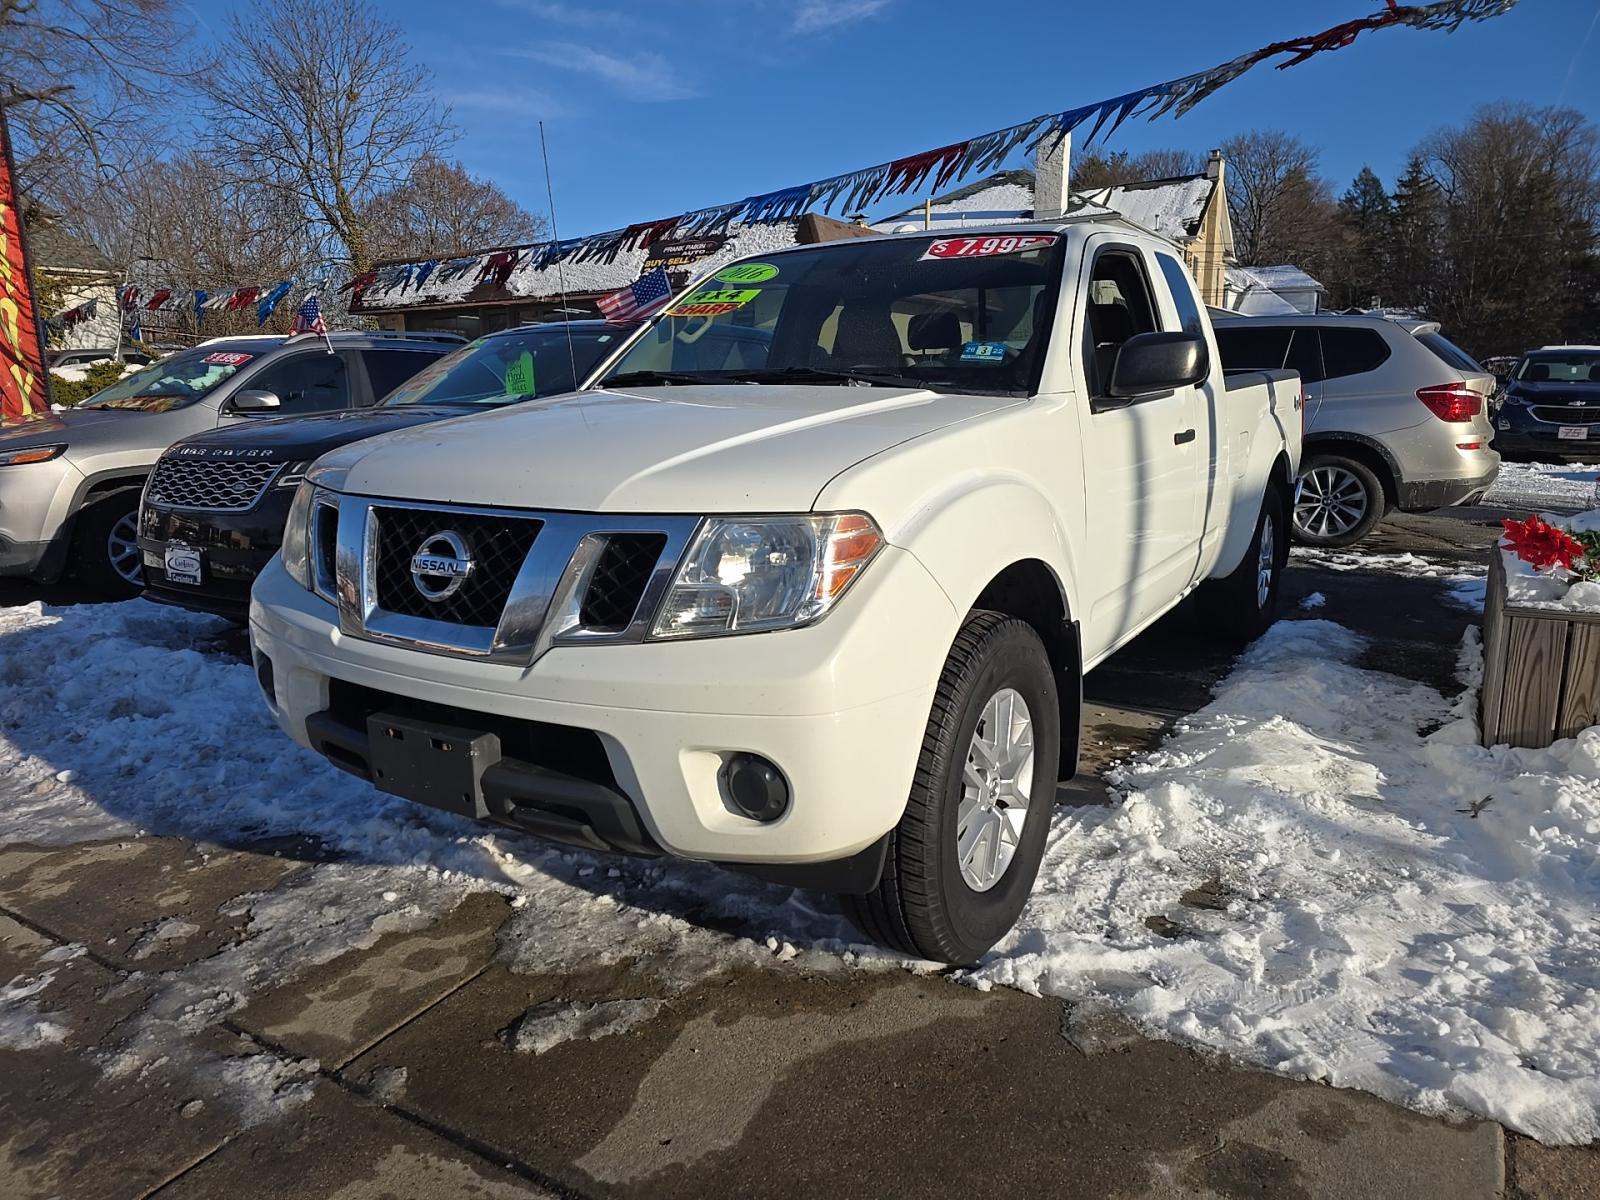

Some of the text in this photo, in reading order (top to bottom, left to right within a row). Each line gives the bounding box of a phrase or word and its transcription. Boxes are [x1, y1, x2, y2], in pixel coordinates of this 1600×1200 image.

[644, 259, 663, 268] BUY
[667, 256, 690, 265] SELL
[413, 558, 459, 573] NISSAN
